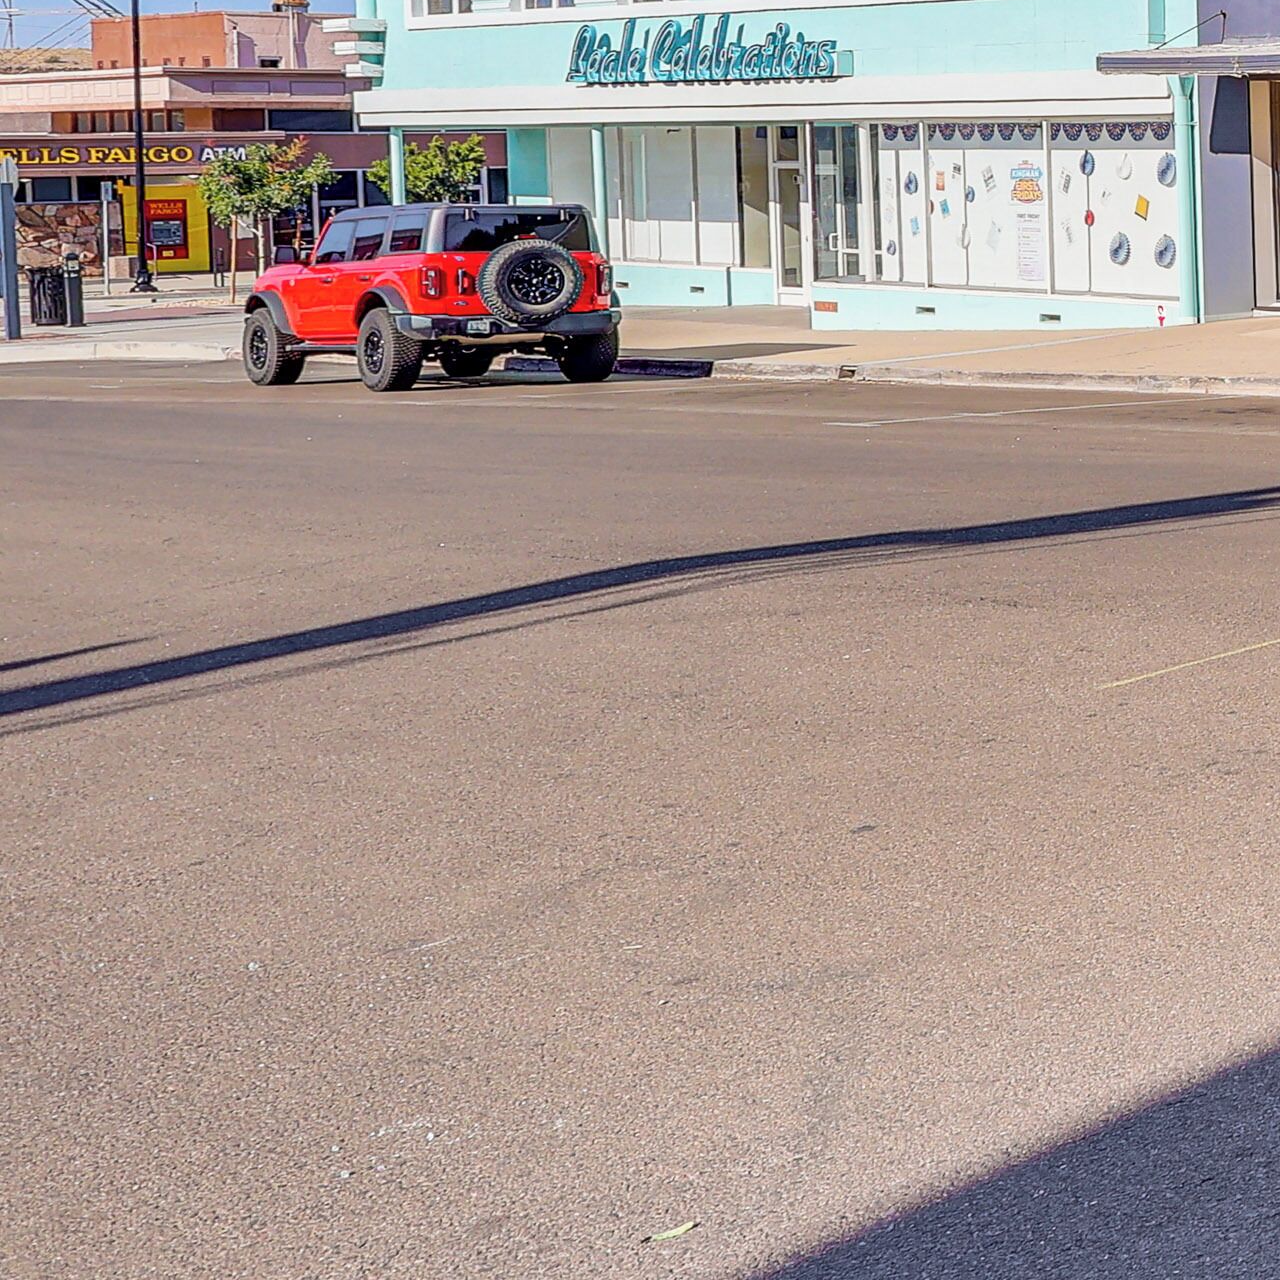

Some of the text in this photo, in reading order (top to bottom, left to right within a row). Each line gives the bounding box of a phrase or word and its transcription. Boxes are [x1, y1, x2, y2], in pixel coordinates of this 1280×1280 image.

[650, 13, 837, 79] Celebrations
[0, 146, 247, 164] ELLS FARGO ATM
[1014, 180, 1039, 191] FIRST
[1011, 190, 1043, 201] FRIDAYS
